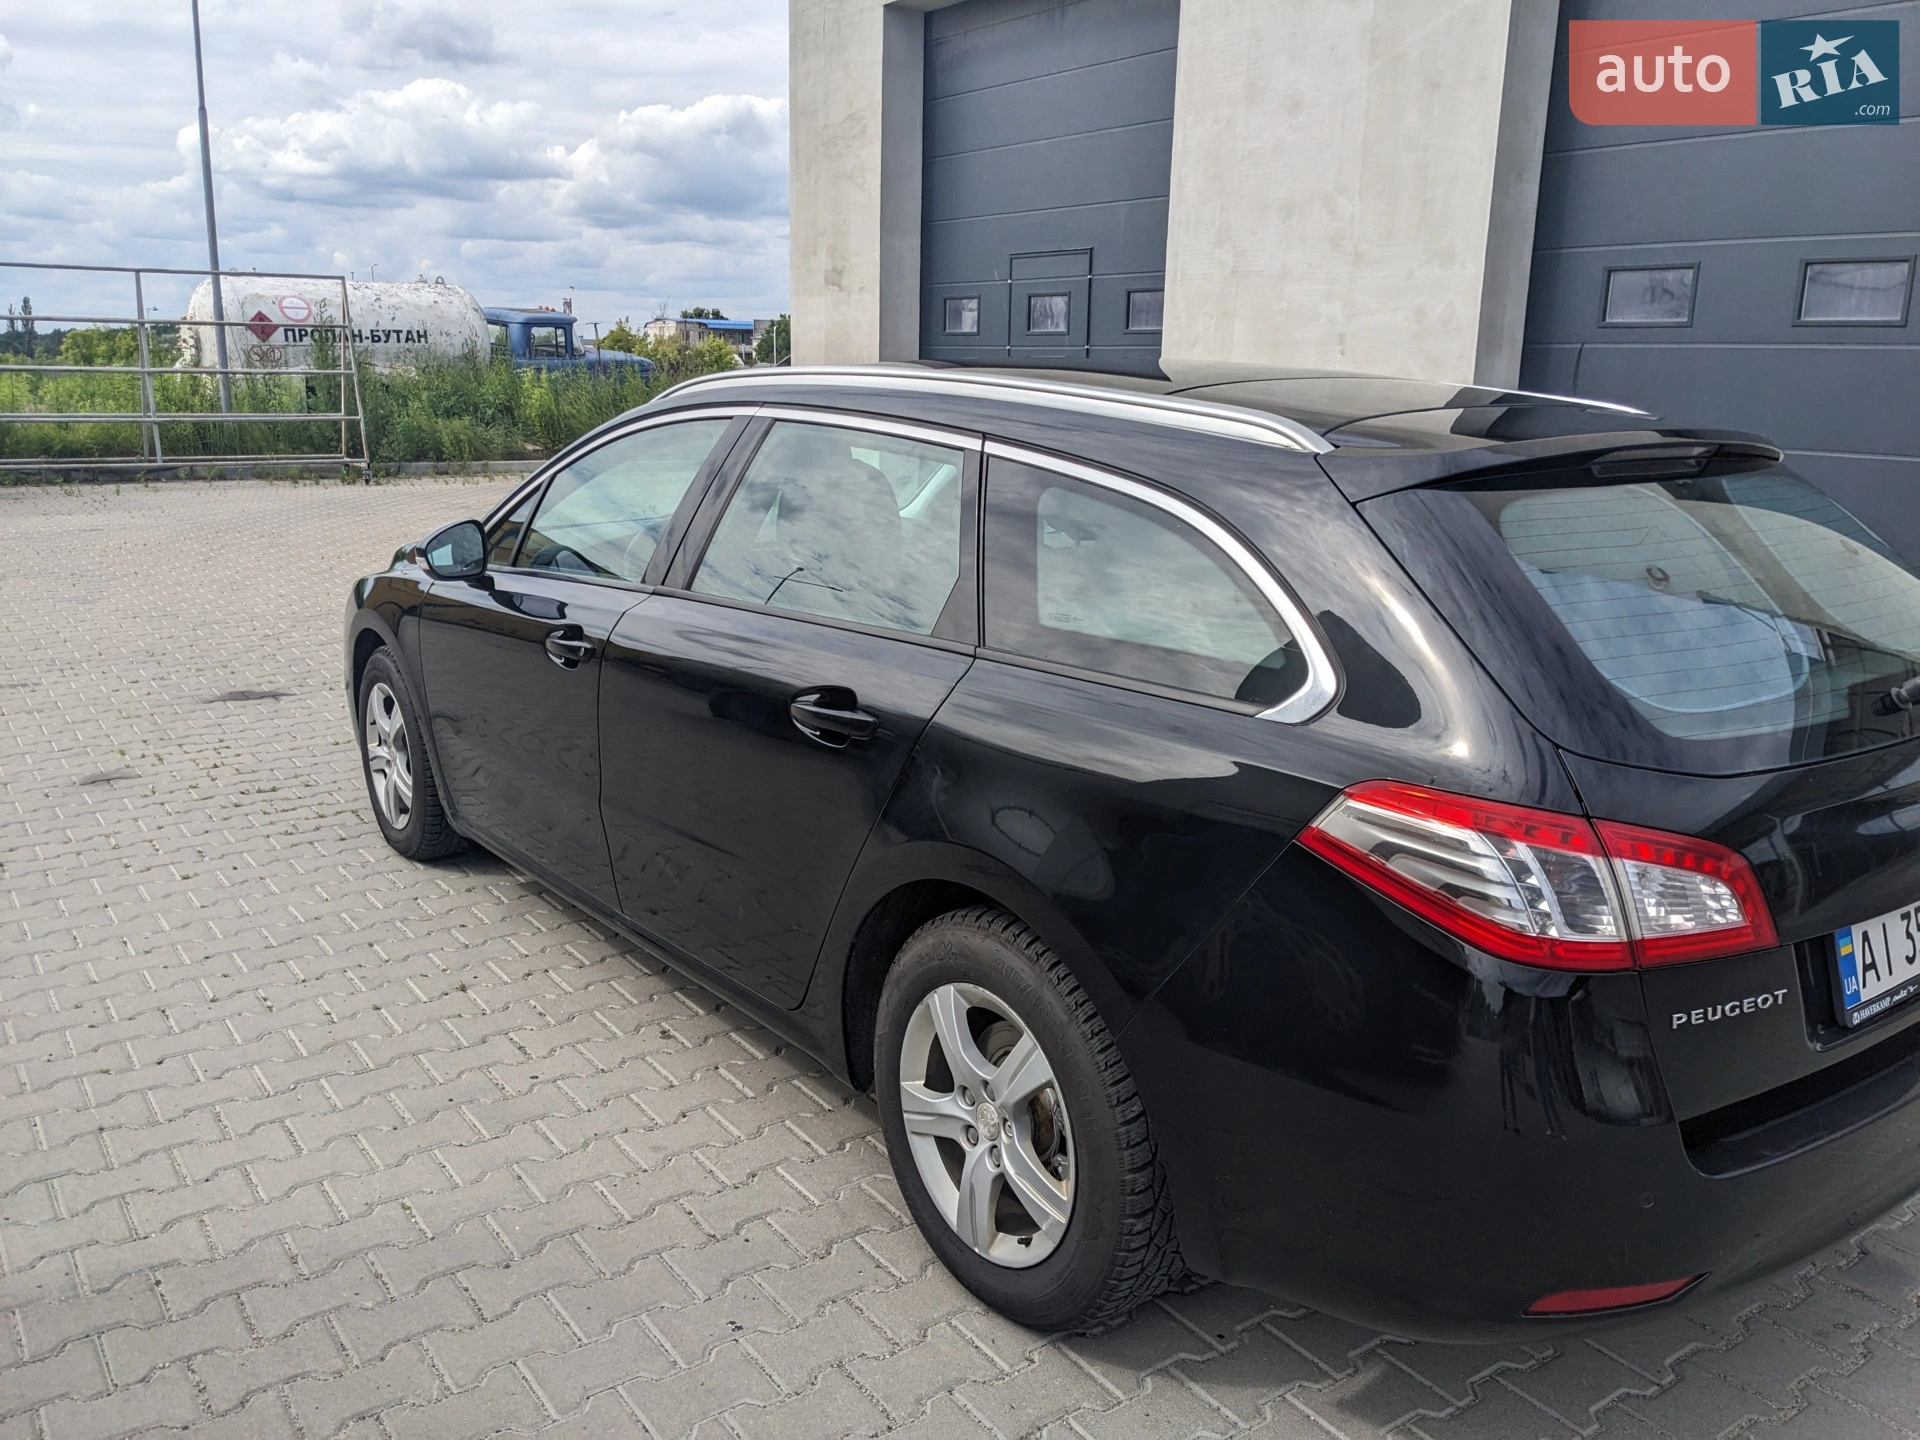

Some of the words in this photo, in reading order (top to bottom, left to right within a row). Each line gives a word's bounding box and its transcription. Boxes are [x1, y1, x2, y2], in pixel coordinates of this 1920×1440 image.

[1861, 922, 1893, 990] AI
[1844, 974, 1860, 996] UA
[1671, 988, 1789, 1031] PEUGEOT
[1859, 996, 1892, 1021] HAVERKAMP
